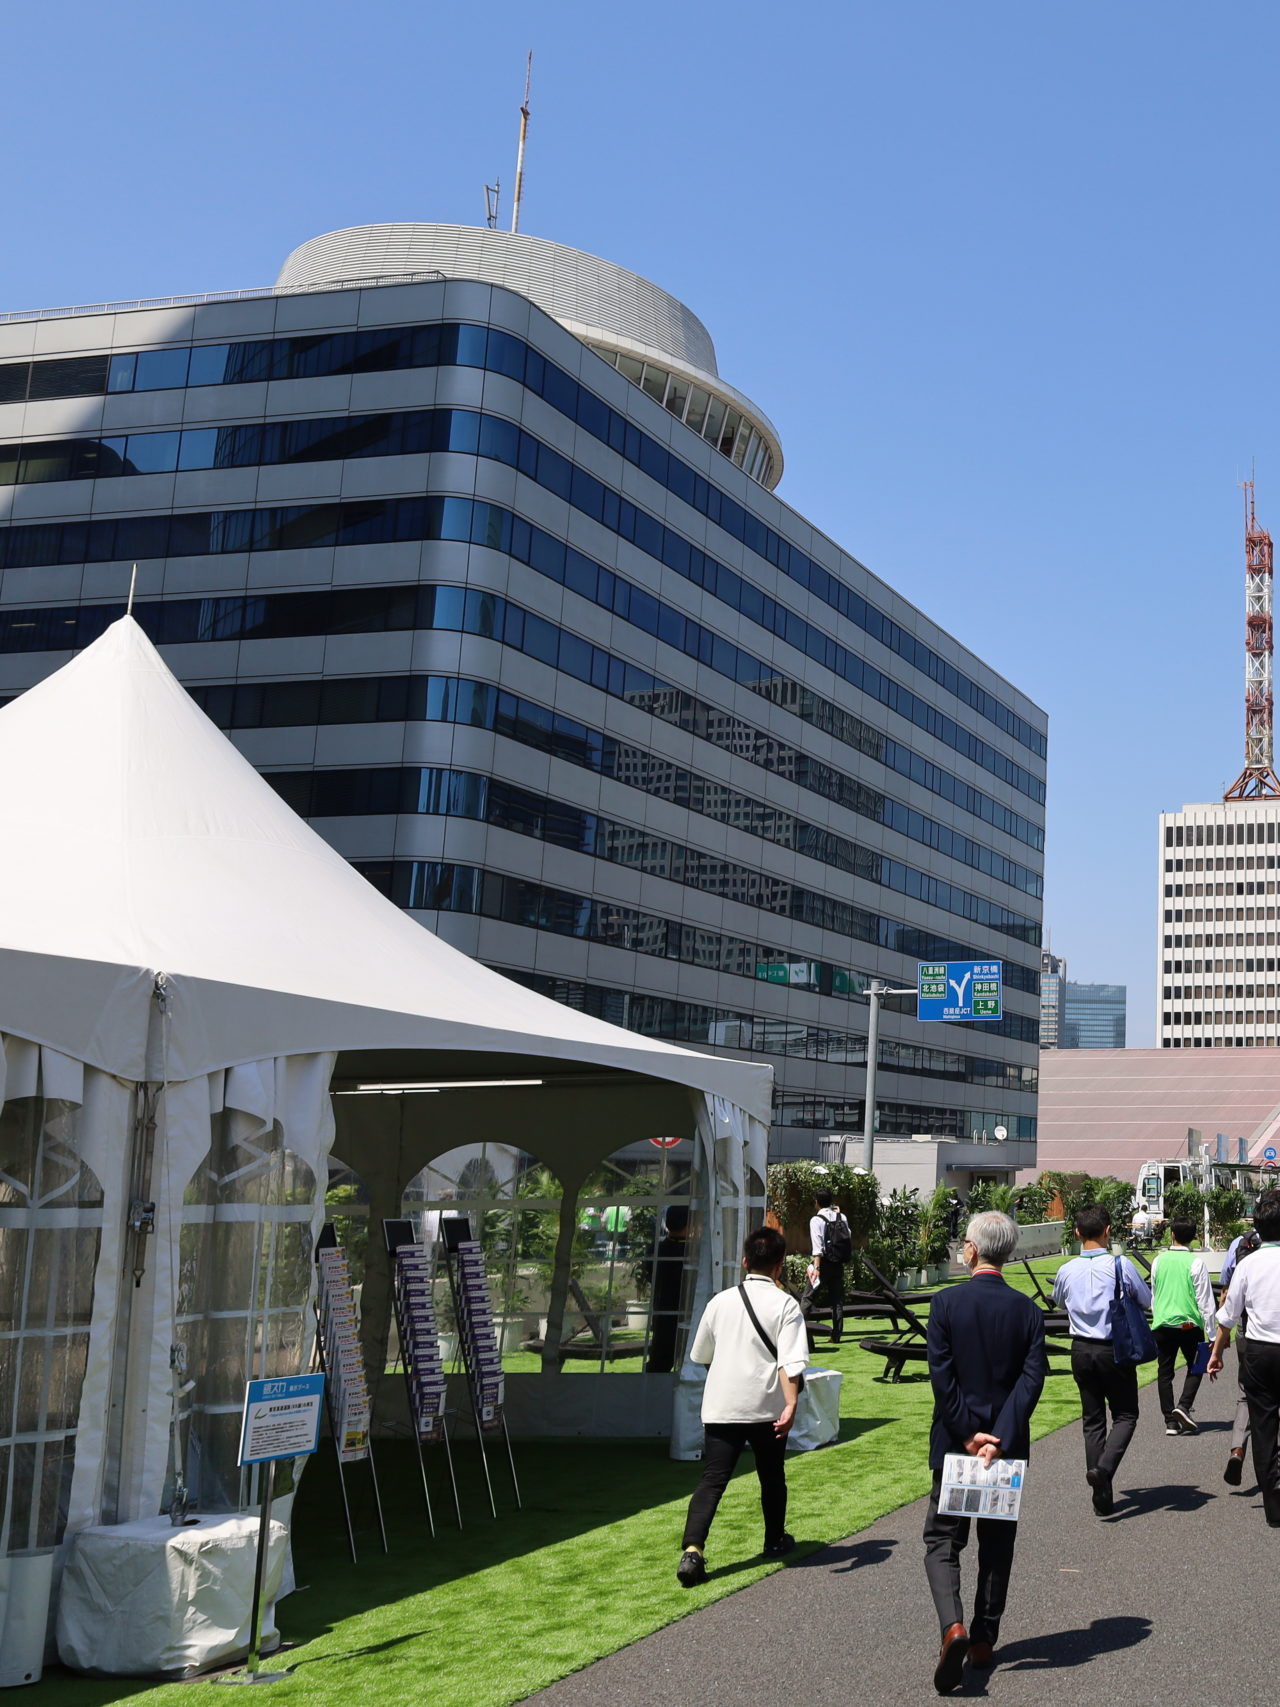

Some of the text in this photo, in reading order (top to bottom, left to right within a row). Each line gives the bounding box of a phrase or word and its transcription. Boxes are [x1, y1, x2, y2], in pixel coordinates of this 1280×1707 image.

[922, 966, 945, 975] 八重洲線
[973, 965, 998, 973] 新京橋
[922, 984, 945, 993] 北池袋
[974, 983, 998, 991] 神田橋
[977, 1001, 995, 1009] 上野
